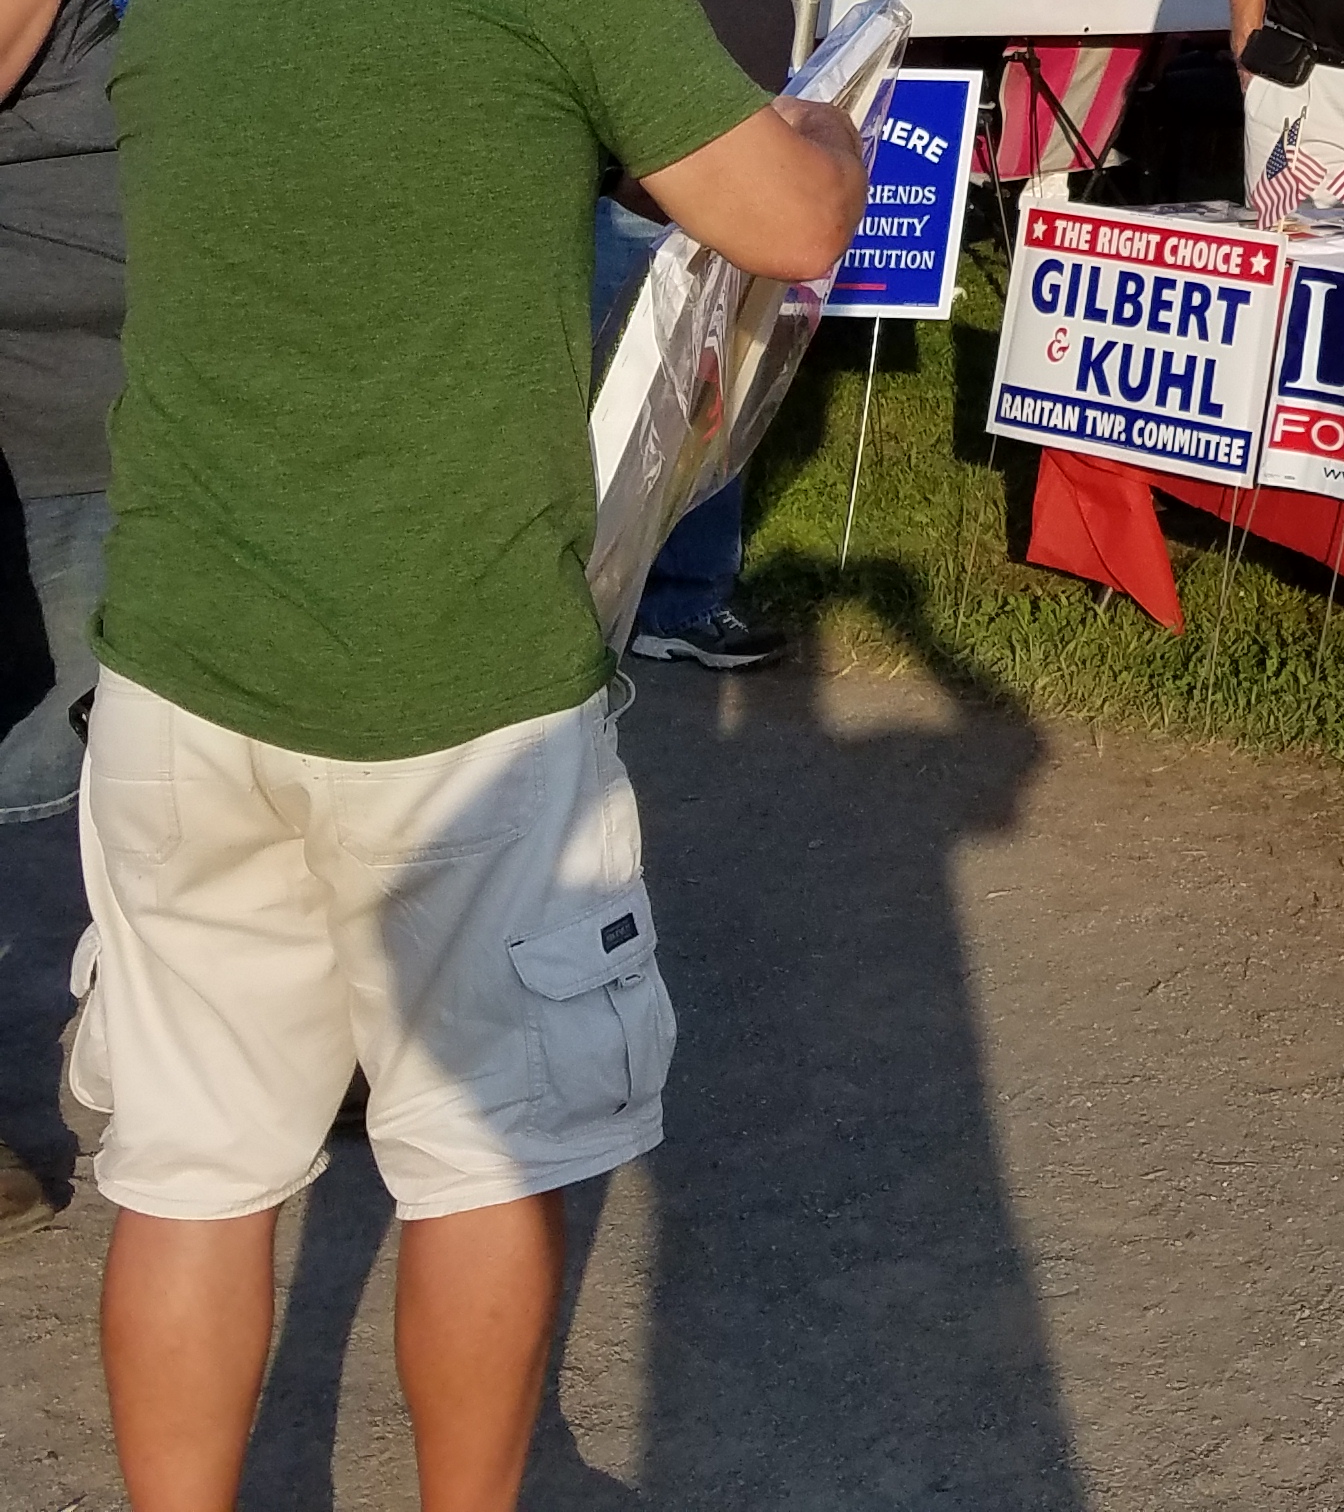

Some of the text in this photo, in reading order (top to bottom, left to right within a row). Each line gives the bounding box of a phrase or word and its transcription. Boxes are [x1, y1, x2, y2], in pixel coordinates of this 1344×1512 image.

[866, 185, 936, 205] RIENDS
[855, 215, 930, 237] UNITY
[1054, 219, 1244, 274] THE RIGHT CHOICE
[844, 249, 935, 270] TITUTION
[1032, 258, 1252, 346] GILBERT
[1047, 327, 1070, 362] &
[1075, 335, 1224, 419] KUHL
[1000, 393, 1245, 466] RARITAN TWP. COMMITTEE
